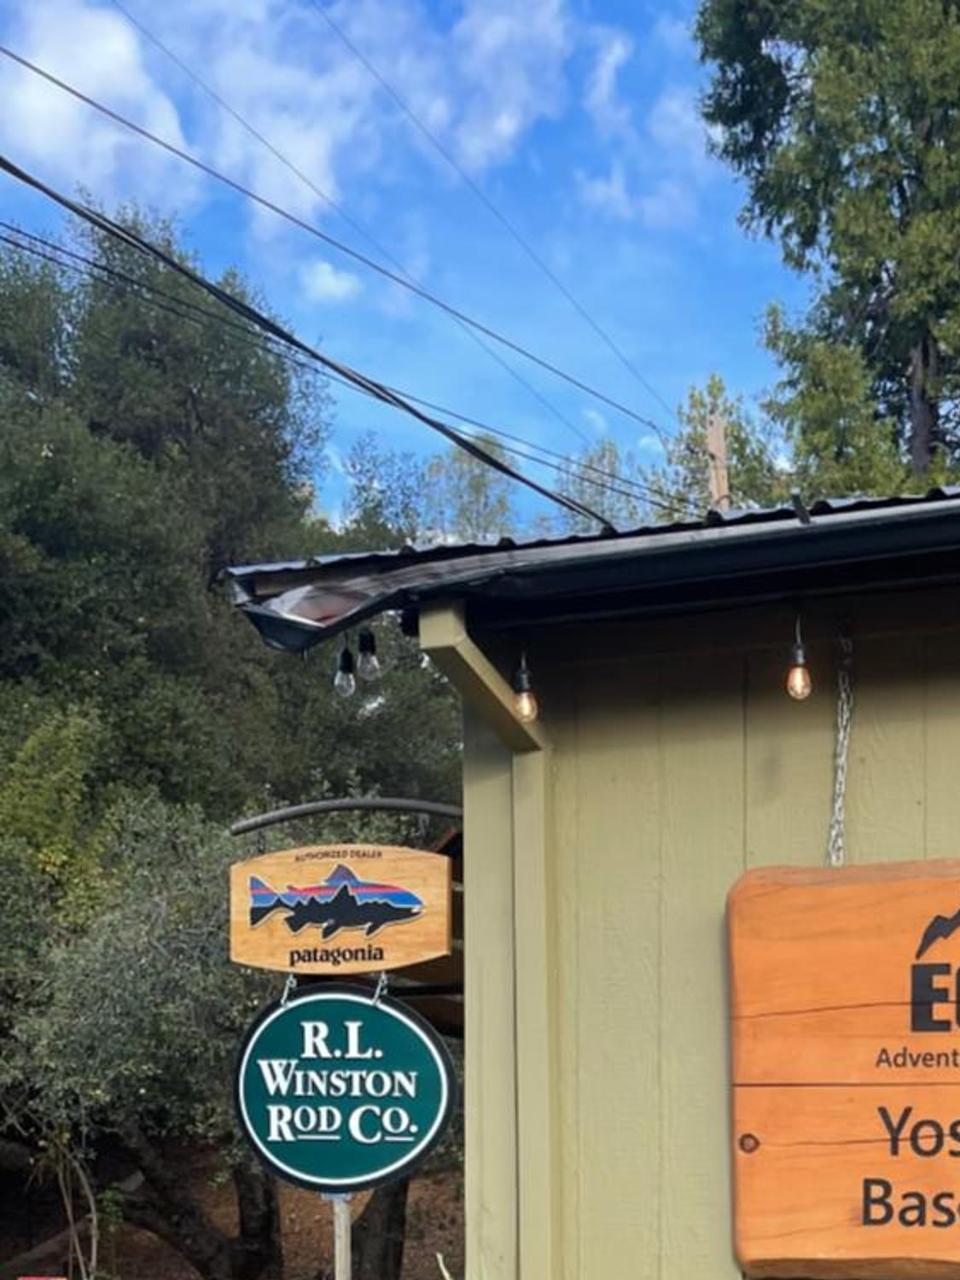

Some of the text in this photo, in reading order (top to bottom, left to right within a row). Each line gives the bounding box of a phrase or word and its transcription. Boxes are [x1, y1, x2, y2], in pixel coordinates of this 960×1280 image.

[350, 849, 383, 859] DEALER
[289, 946, 384, 967] patagonia
[301, 1021, 383, 1059] R.L.
[258, 1059, 418, 1098] WINSTON
